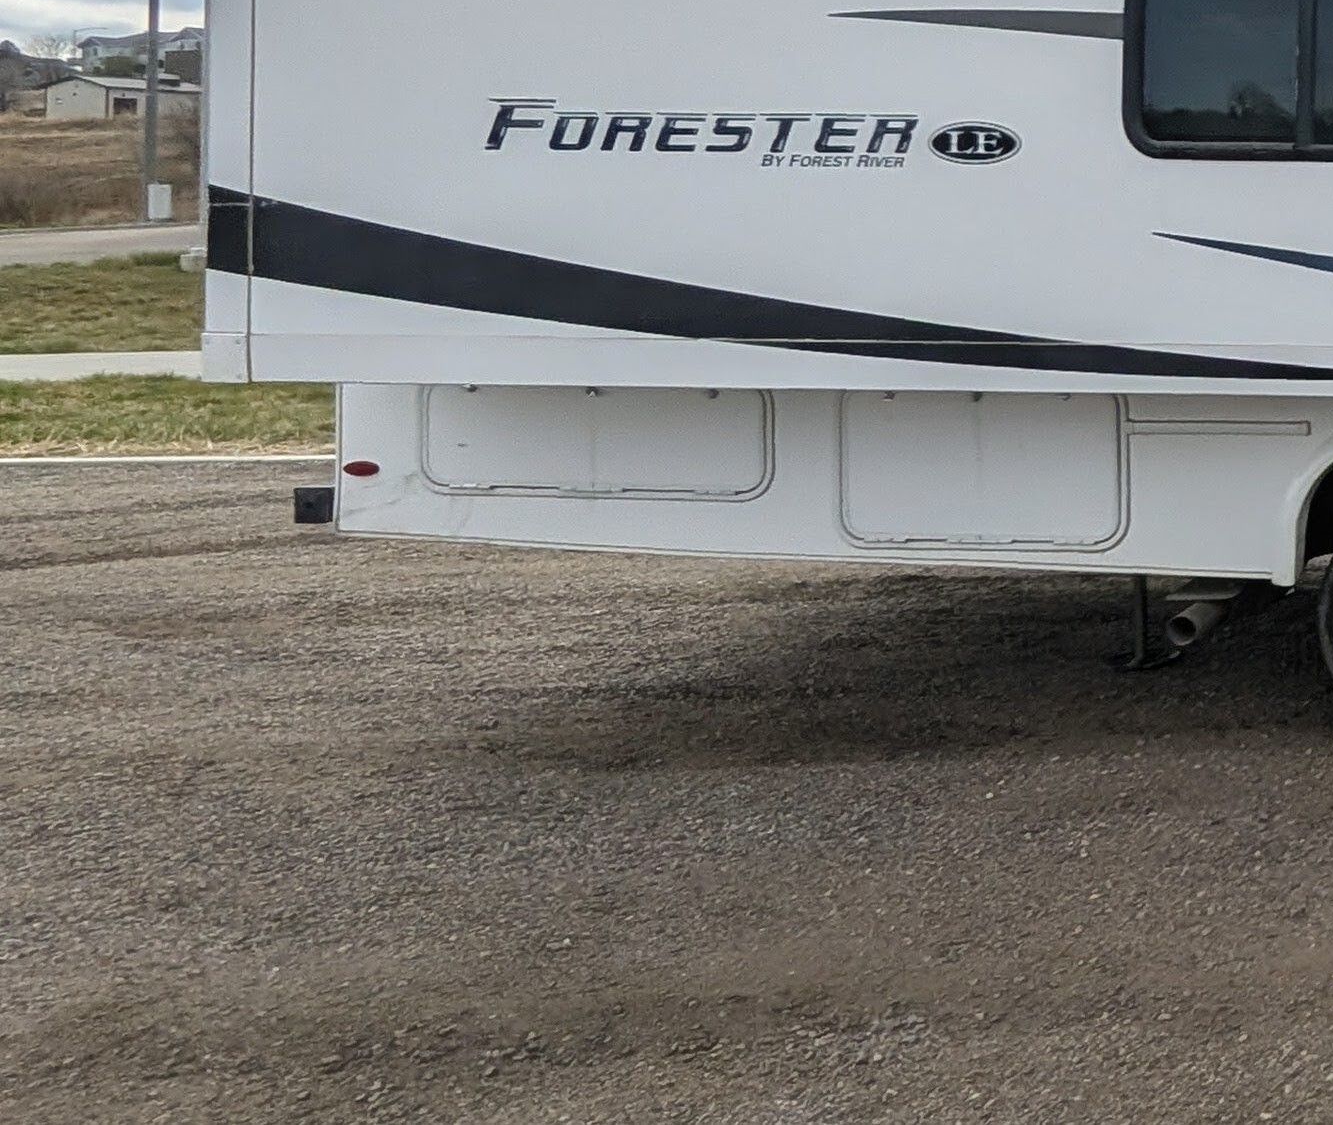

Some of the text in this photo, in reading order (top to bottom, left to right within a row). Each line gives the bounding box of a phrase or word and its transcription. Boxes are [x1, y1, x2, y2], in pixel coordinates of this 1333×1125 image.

[485, 98, 1004, 155] FORESTER LE
[761, 154, 905, 168] BY FOREST RIVER
